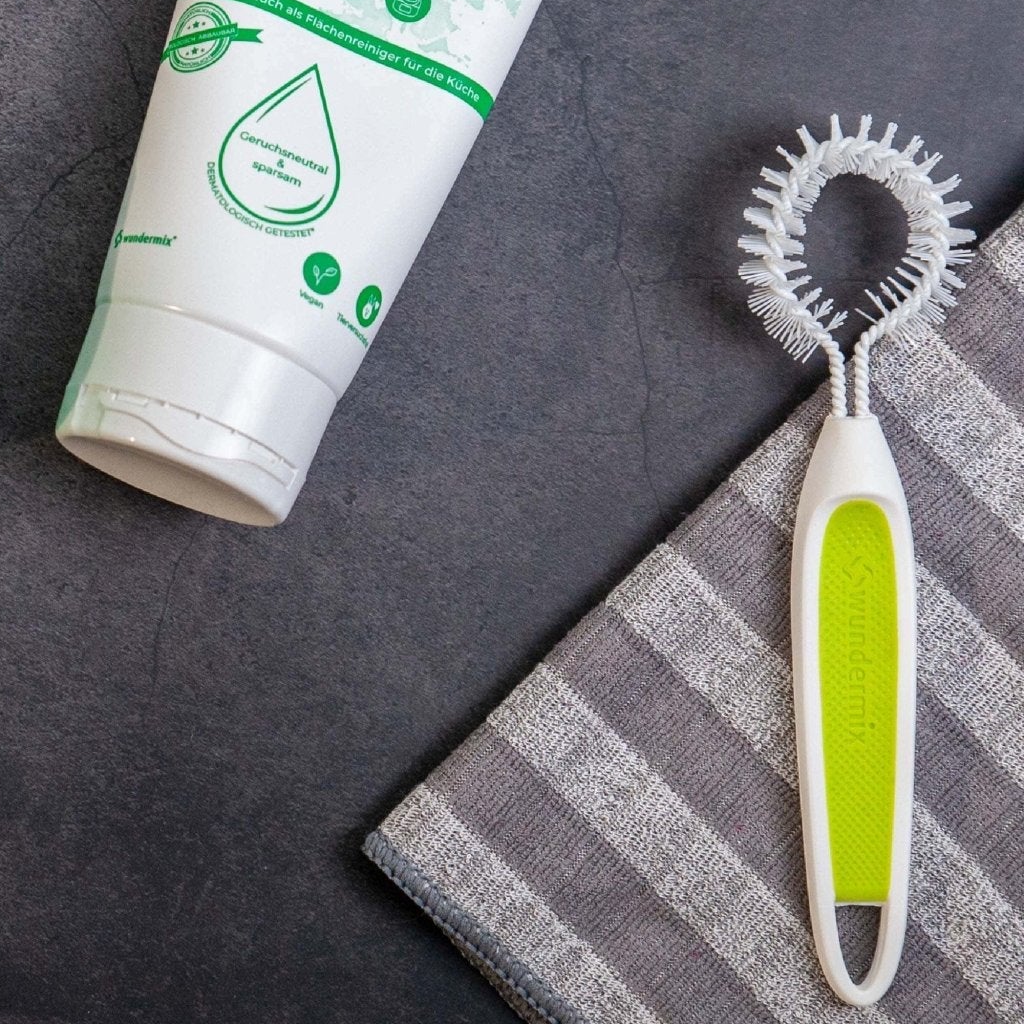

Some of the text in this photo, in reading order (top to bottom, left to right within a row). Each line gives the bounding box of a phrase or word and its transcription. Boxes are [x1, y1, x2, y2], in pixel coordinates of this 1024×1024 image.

[286, 2, 304, 21] als
[306, 13, 402, 63] Flächenreiniger
[403, 55, 423, 73] für
[424, 64, 445, 82] die
[446, 73, 481, 103] Küche
[239, 130, 329, 175] Geruchsneutral
[251, 161, 302, 188] sparsam
[276, 159, 285, 169] &
[207, 161, 264, 232] DERMATOLOGISCH
[299, 289, 324, 310] Vegan
[849, 589, 876, 745] wundermix
